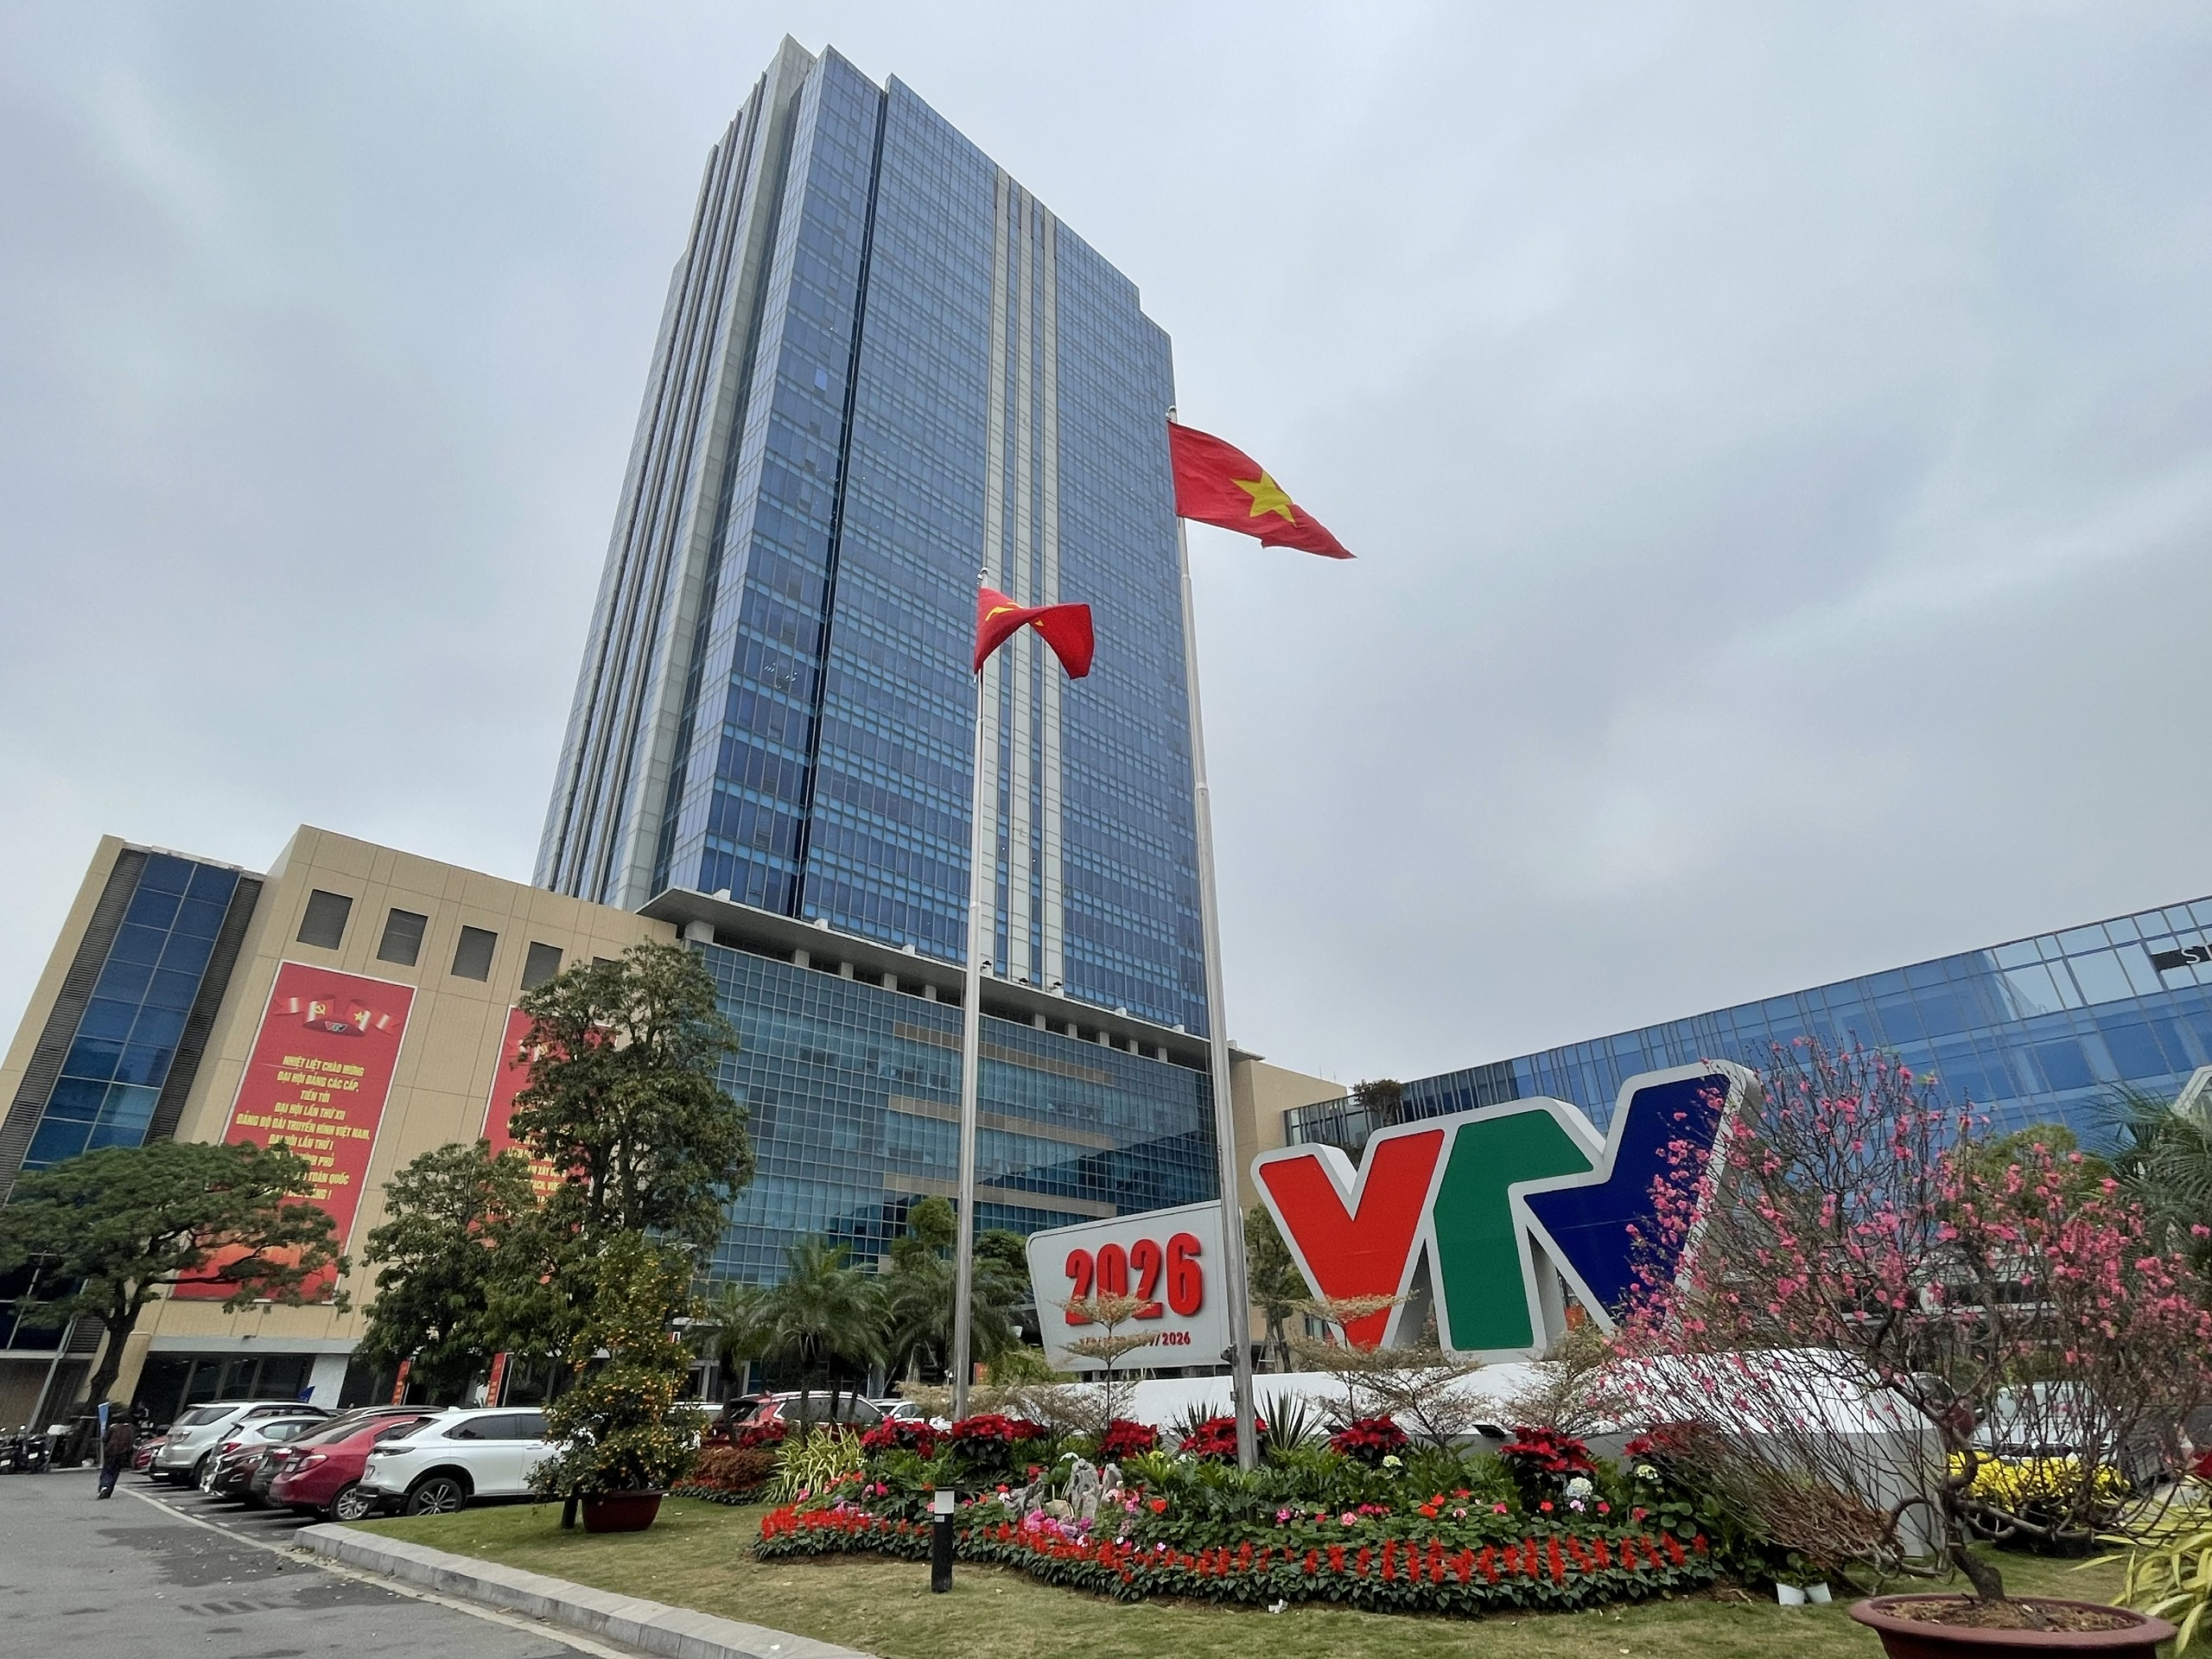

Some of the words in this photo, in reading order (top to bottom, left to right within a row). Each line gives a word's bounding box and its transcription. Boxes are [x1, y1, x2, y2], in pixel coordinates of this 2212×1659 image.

[282, 1056, 306, 1070] NHIỆT
[305, 1058, 321, 1071] LIỆT
[321, 1061, 342, 1073] CHÀO
[276, 1071, 292, 1084] ĐẠI
[291, 1071, 306, 1085] HỘI
[306, 1071, 327, 1087] ĐẢNG
[327, 1077, 343, 1090] CÁC
[301, 1088, 318, 1101] TIẾN
[275, 1103, 289, 1115] ĐẠI
[289, 1103, 304, 1116] HỘI
[236, 1110, 259, 1126] ĐẢNG
[335, 1125, 352, 1138] VIỆT
[318, 1153, 334, 1167] PHỦ
[308, 1171, 327, 1183] TOÀN
[329, 1172, 349, 1185] QUỐC
[305, 1184, 327, 1199] ẢNG
[1251, 1061, 1732, 1360] VTV
[1065, 1232, 1204, 1326] 2026
